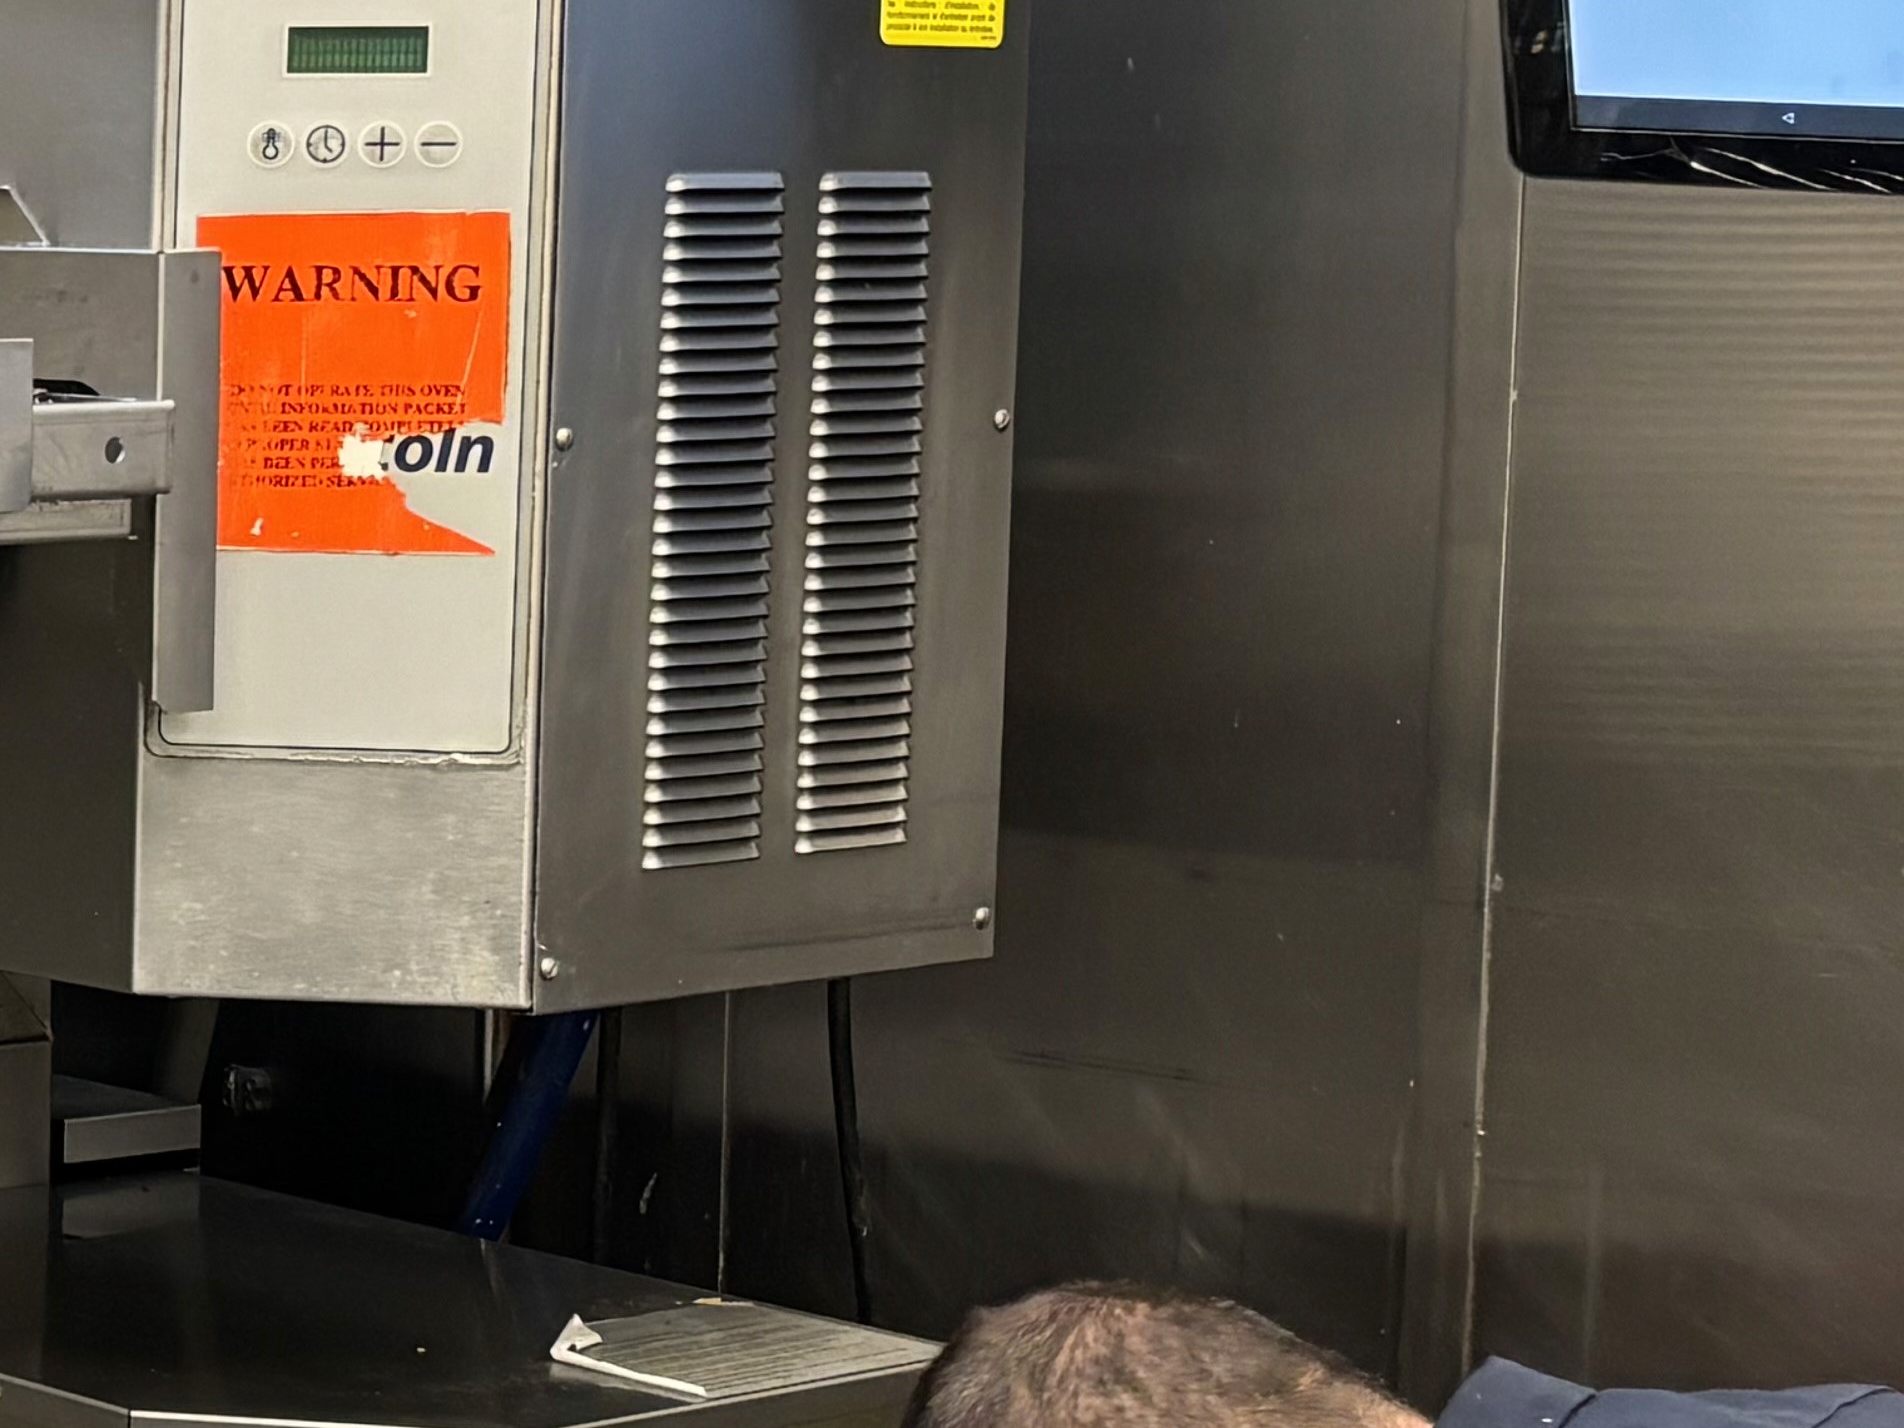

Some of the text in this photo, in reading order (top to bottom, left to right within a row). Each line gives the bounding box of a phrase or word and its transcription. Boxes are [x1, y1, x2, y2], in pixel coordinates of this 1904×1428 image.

[222, 264, 482, 303] WARNING
[380, 384, 416, 397] THIS
[420, 384, 465, 398] OVEN
[404, 403, 466, 415] PACKET
[379, 428, 495, 473] oln
